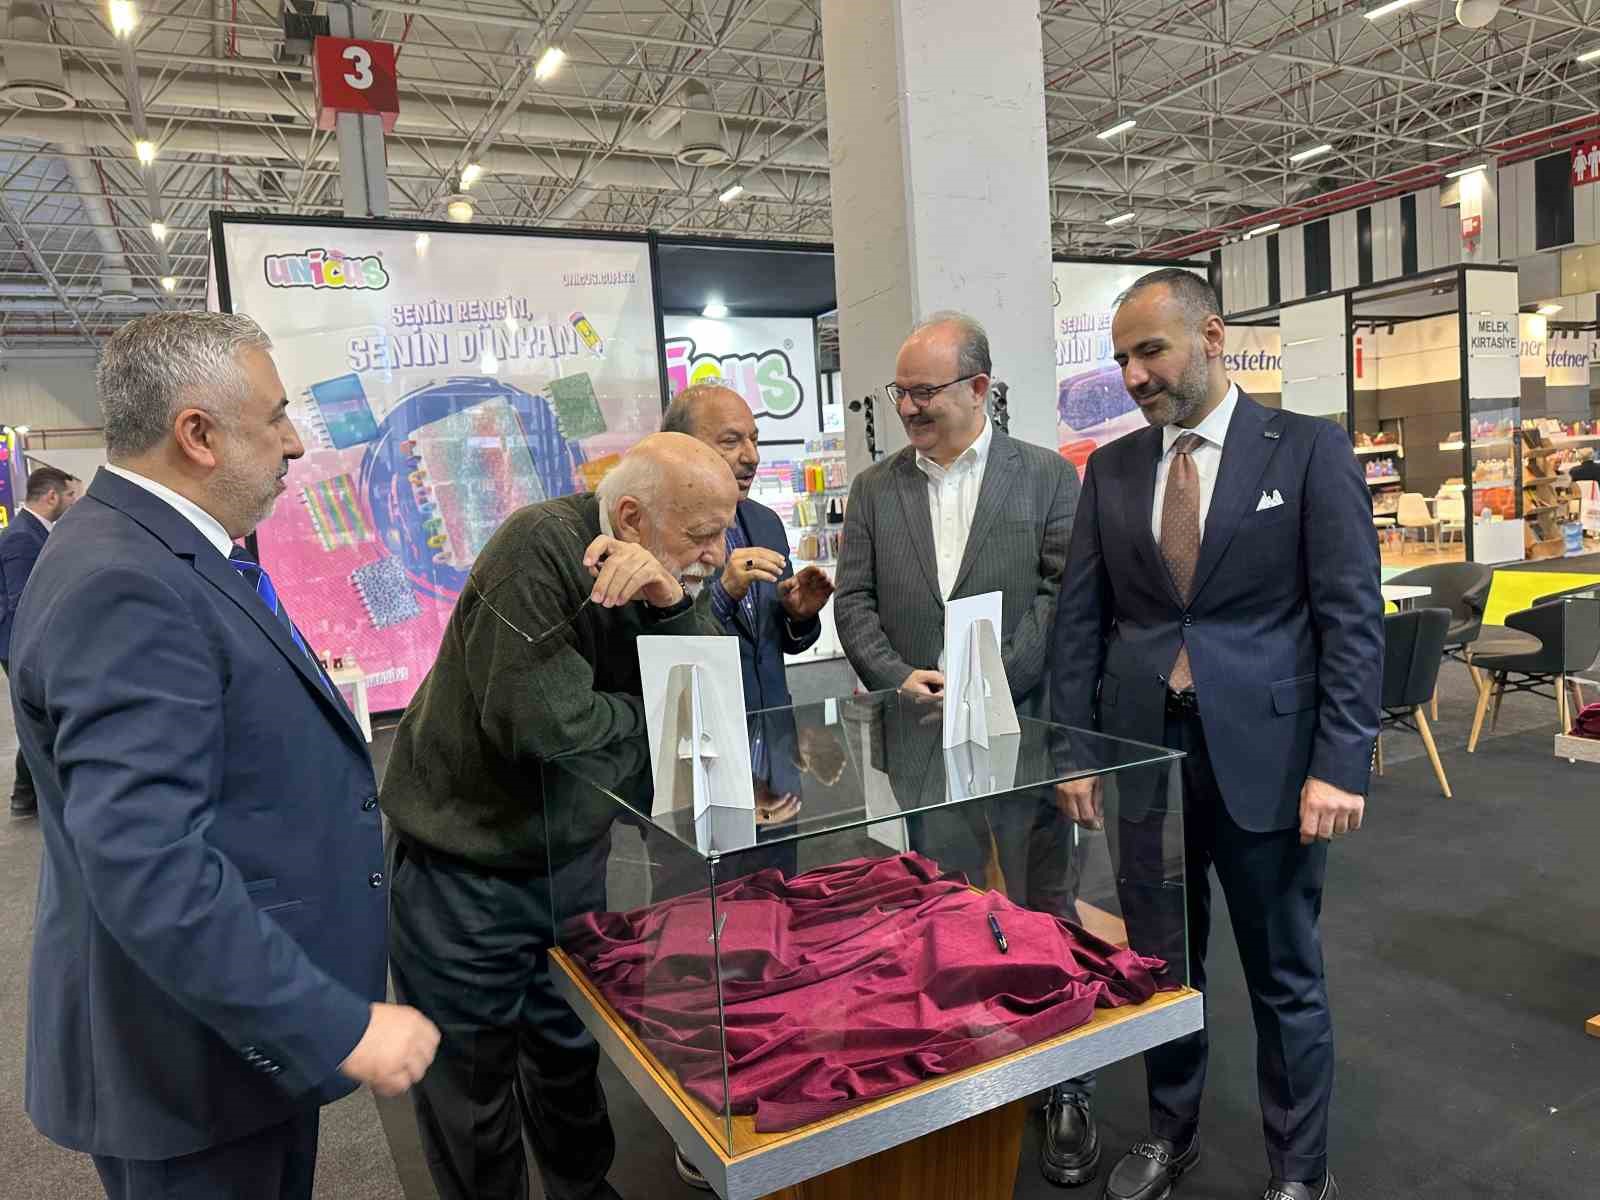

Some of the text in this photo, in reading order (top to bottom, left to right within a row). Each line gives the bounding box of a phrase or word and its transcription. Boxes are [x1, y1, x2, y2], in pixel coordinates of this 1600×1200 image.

[342, 45, 374, 90] 3
[391, 299, 453, 327] SENİN
[1478, 320, 1509, 333] MELEK
[345, 328, 449, 372] SENİN
